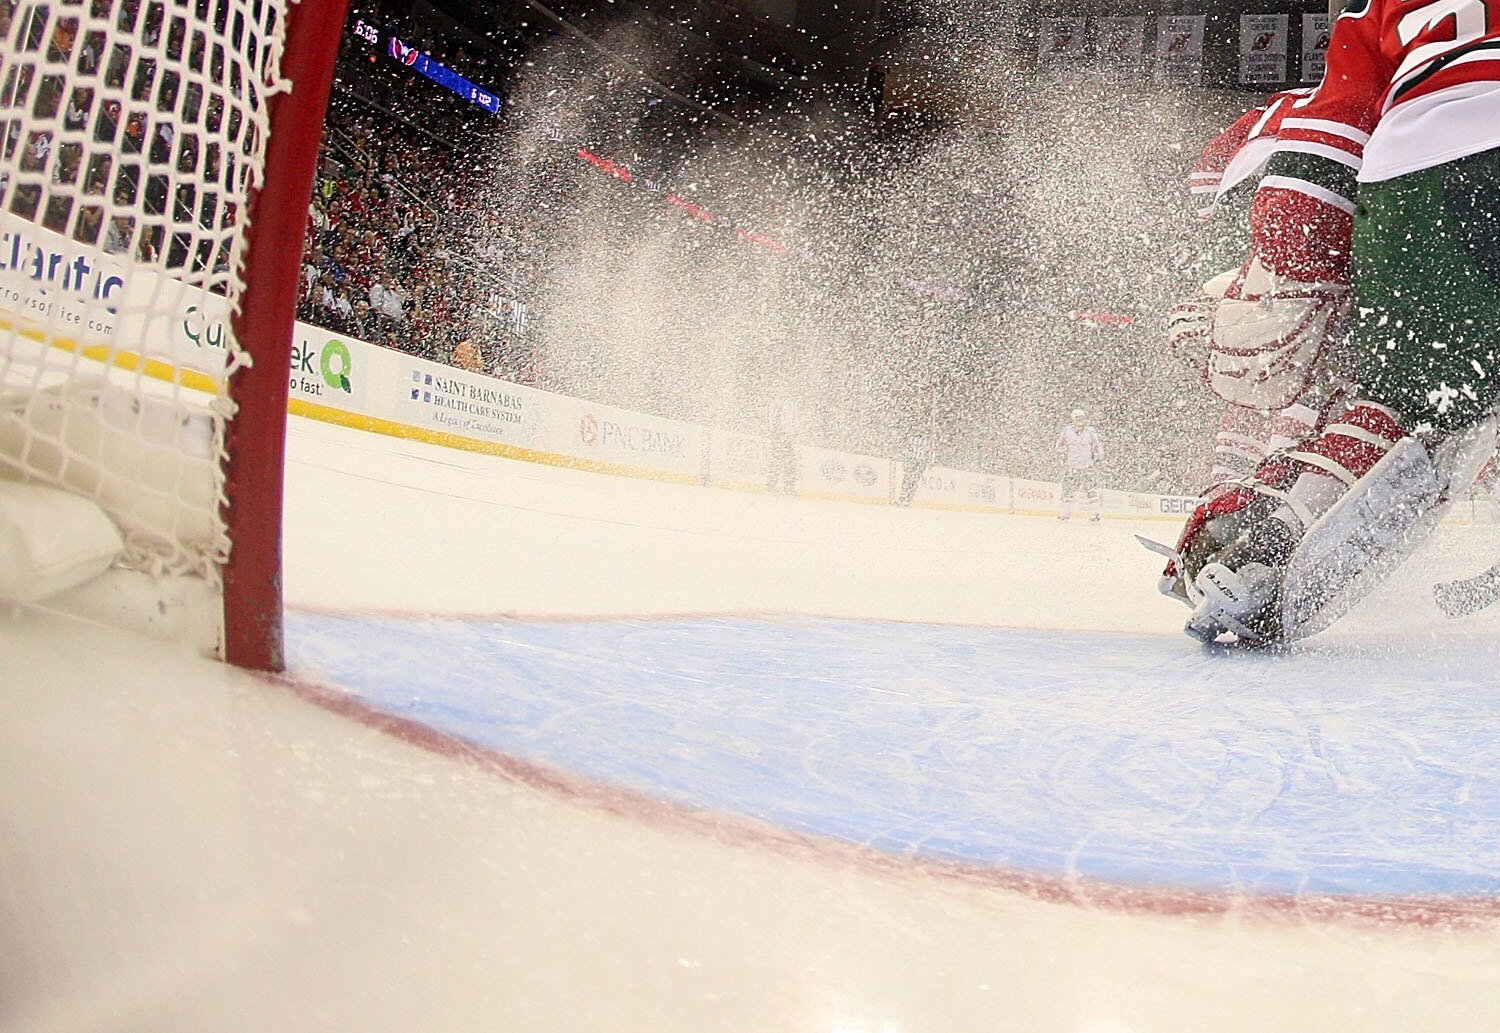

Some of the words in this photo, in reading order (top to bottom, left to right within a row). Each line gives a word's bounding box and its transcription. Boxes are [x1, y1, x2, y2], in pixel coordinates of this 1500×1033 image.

[434, 395, 467, 412] HEALTH
[469, 404, 491, 417] CARE
[492, 408, 522, 425] SYSTEM
[435, 377, 467, 398] SAINT
[469, 384, 522, 411] BARNABAS
